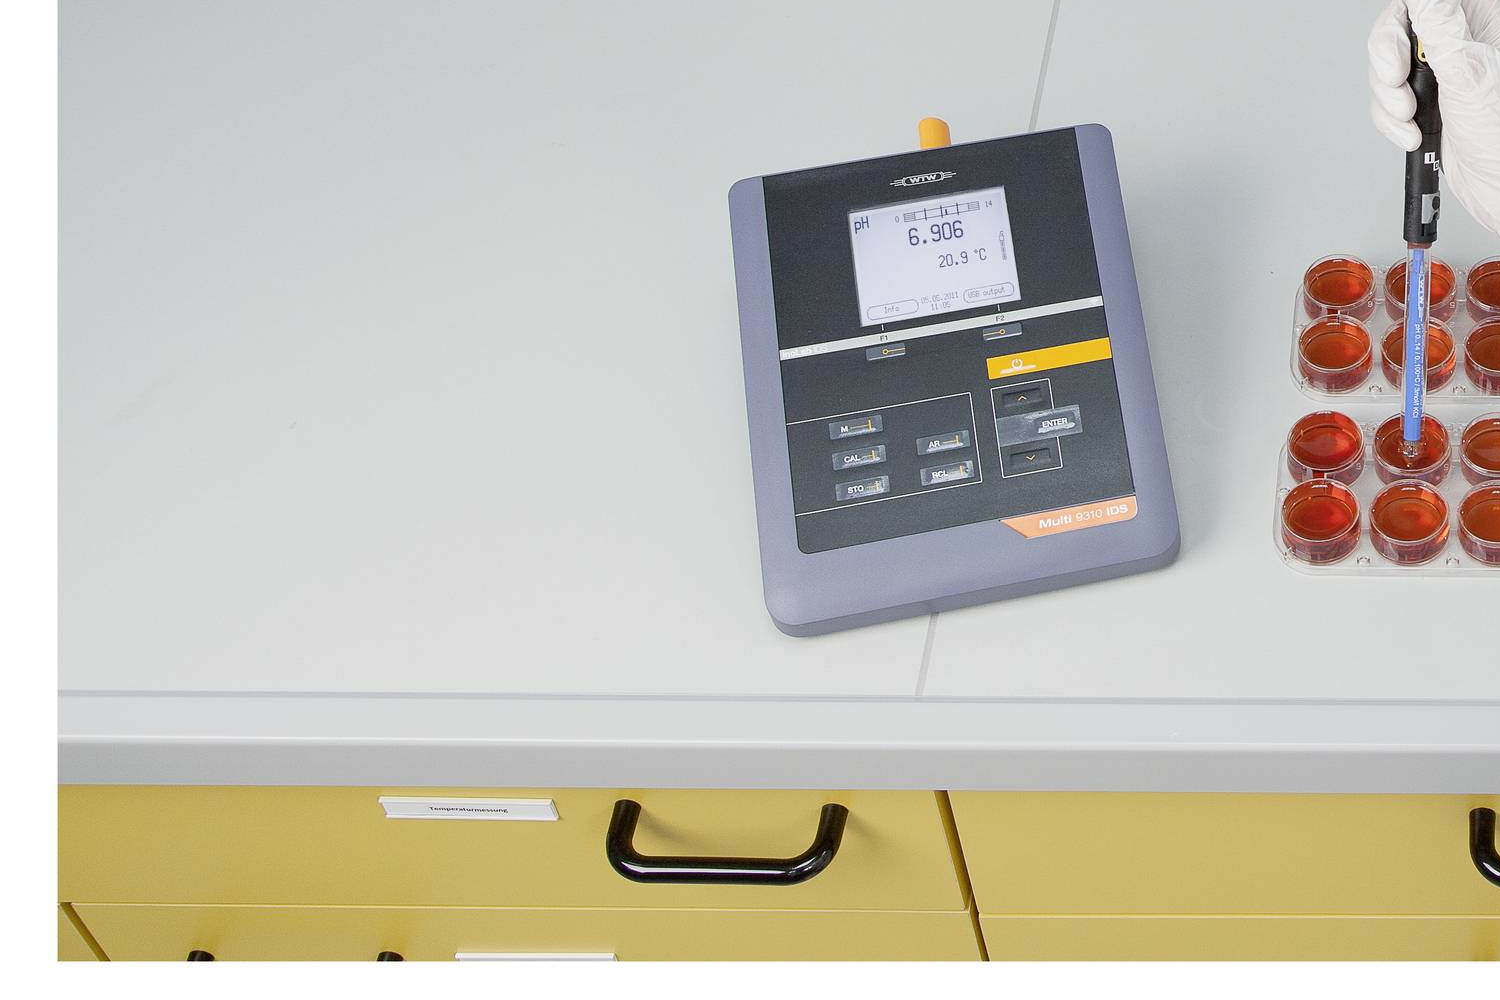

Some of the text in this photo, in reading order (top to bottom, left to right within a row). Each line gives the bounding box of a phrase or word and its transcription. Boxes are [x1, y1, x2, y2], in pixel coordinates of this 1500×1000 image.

[909, 174, 938, 184] WTW
[985, 200, 993, 208] 14
[854, 216, 870, 235] pH
[908, 219, 964, 246] 6.906
[938, 247, 987, 268] 20.9 °C
[982, 286, 1006, 298] output
[884, 305, 900, 315] Info
[995, 314, 1006, 323] F2
[879, 335, 889, 343] F1
[1041, 417, 1068, 428] ENTER
[840, 425, 849, 433] M
[928, 440, 940, 448] AR
[843, 454, 861, 463] CAL
[931, 469, 949, 479] RCL
[847, 484, 865, 494] STO
[1039, 503, 1129, 529] Multi 9310 IDS
